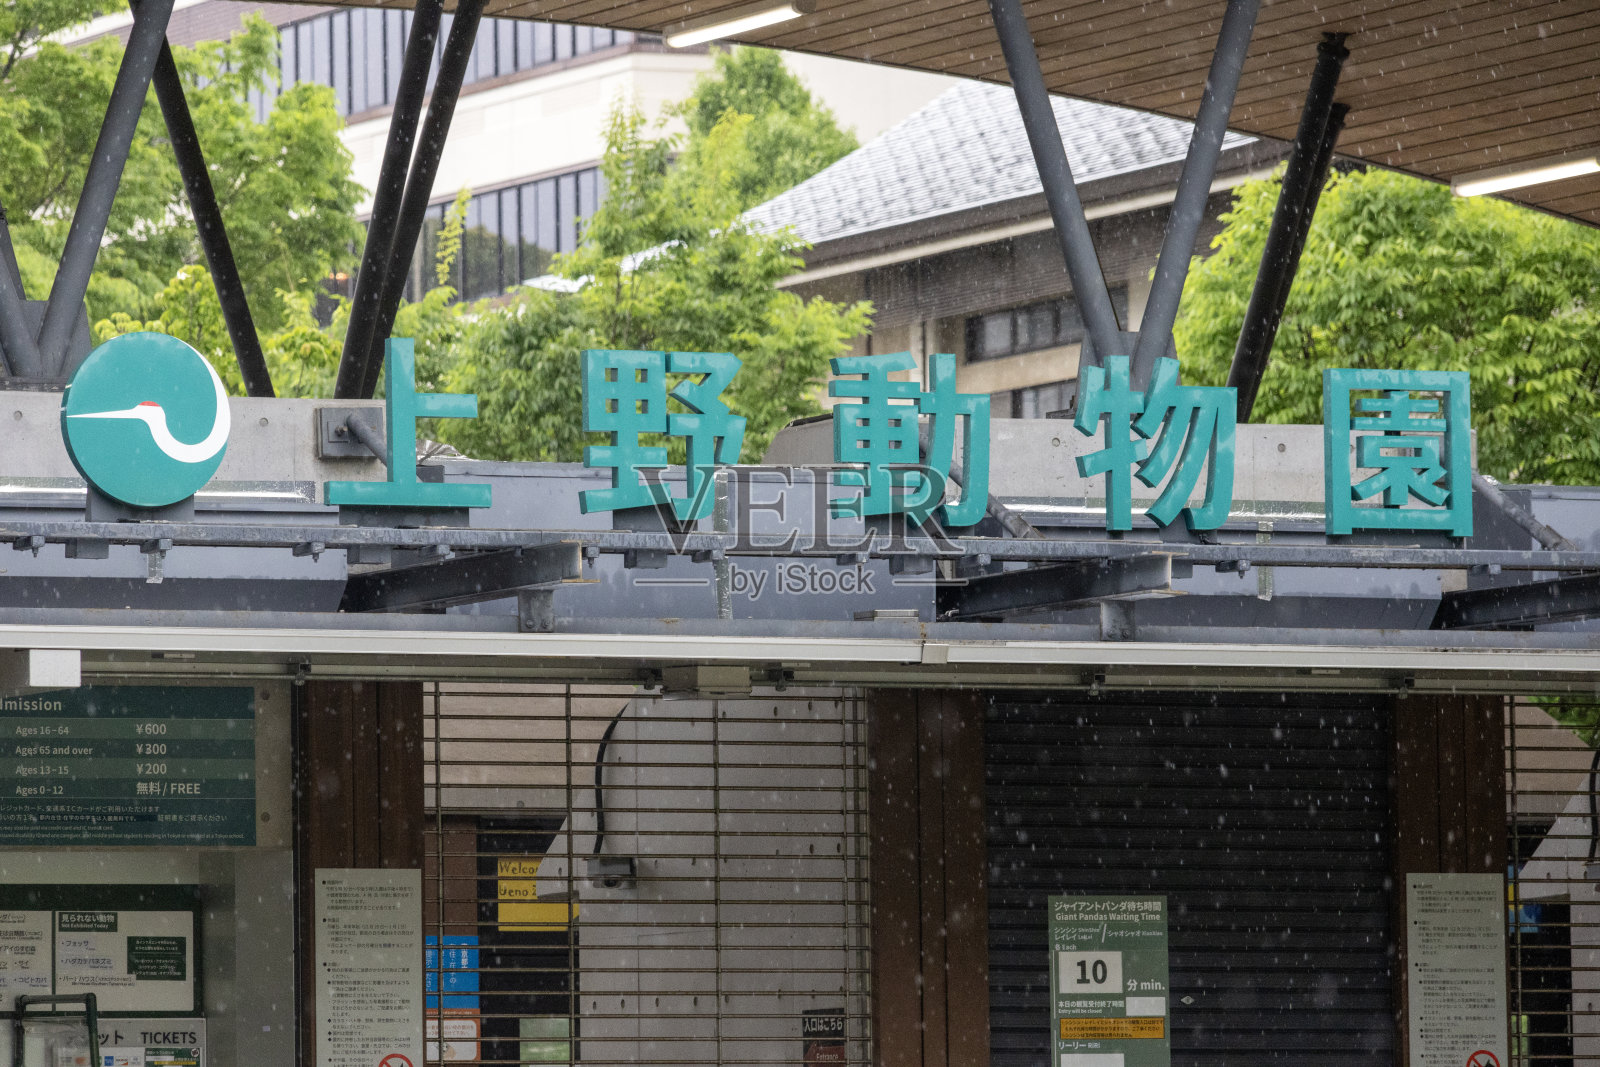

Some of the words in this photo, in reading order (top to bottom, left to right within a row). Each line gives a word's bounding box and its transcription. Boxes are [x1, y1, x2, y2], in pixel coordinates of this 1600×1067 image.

[323, 337, 1473, 538] 上野動物園
[15, 725, 38, 737] Ages
[135, 723, 167, 735] ¥600
[15, 745, 38, 757] Ages
[39, 745, 51, 755] 65
[52, 745, 70, 755] and
[72, 747, 94, 755] over
[15, 764, 38, 777] Ages
[15, 785, 38, 797] Ages
[170, 783, 201, 795] FREE
[499, 884, 529, 897] Ueno
[1054, 901, 1162, 912] ジャイアントパンダ待ち時間
[62, 914, 115, 923] 見られない動物
[1055, 912, 1078, 921] Giant
[1079, 912, 1108, 921] Pandas
[1109, 912, 1140, 922] Waiting
[1141, 912, 1161, 921] Time
[1076, 959, 1108, 984] 10
[1127, 979, 1138, 991] 分
[1140, 979, 1166, 990] min.
[804, 1017, 843, 1032] 入口はこちら
[140, 1031, 197, 1044] TICKETS
[1058, 1041, 1087, 1050] リーリー
